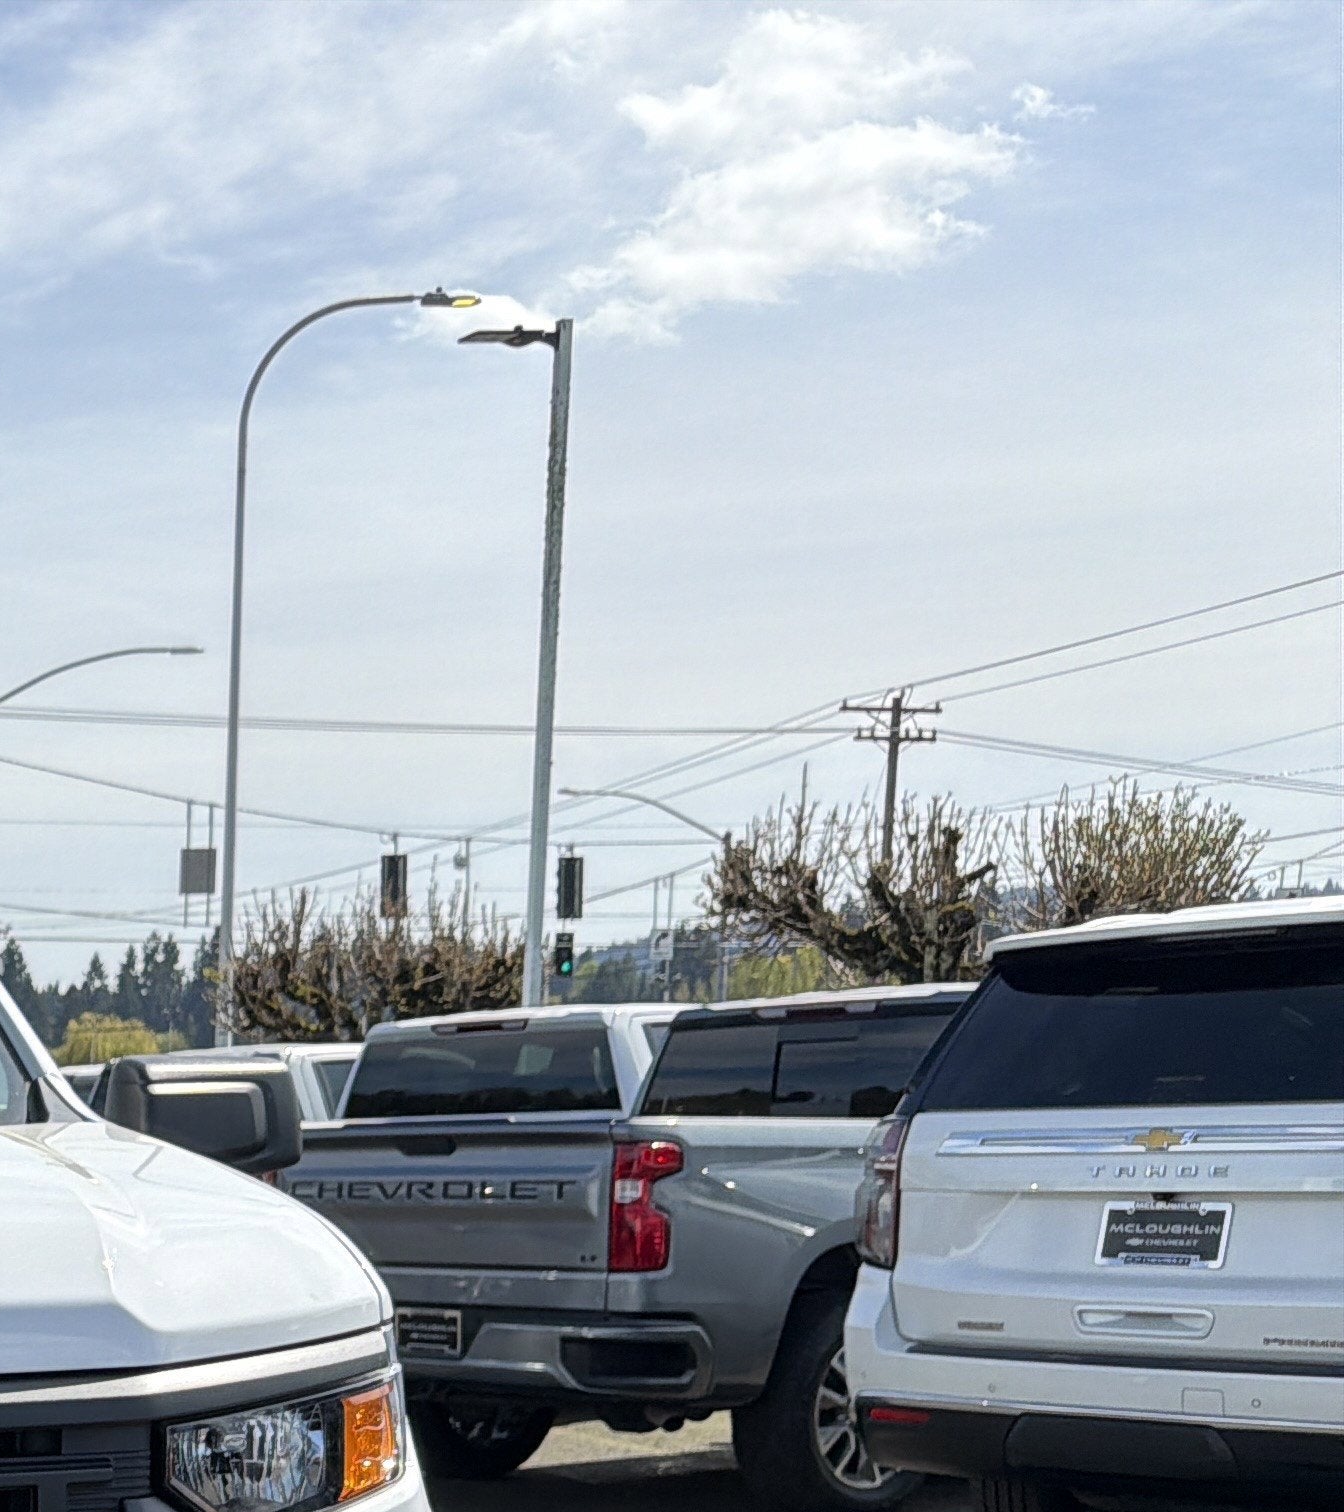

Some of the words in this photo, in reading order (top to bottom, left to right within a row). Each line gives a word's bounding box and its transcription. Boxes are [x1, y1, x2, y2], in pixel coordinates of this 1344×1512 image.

[1090, 1164, 1230, 1178] TAHOE
[291, 1179, 576, 1200] CHEVROLET
[1109, 1222, 1221, 1235] MCLOUGHLIN
